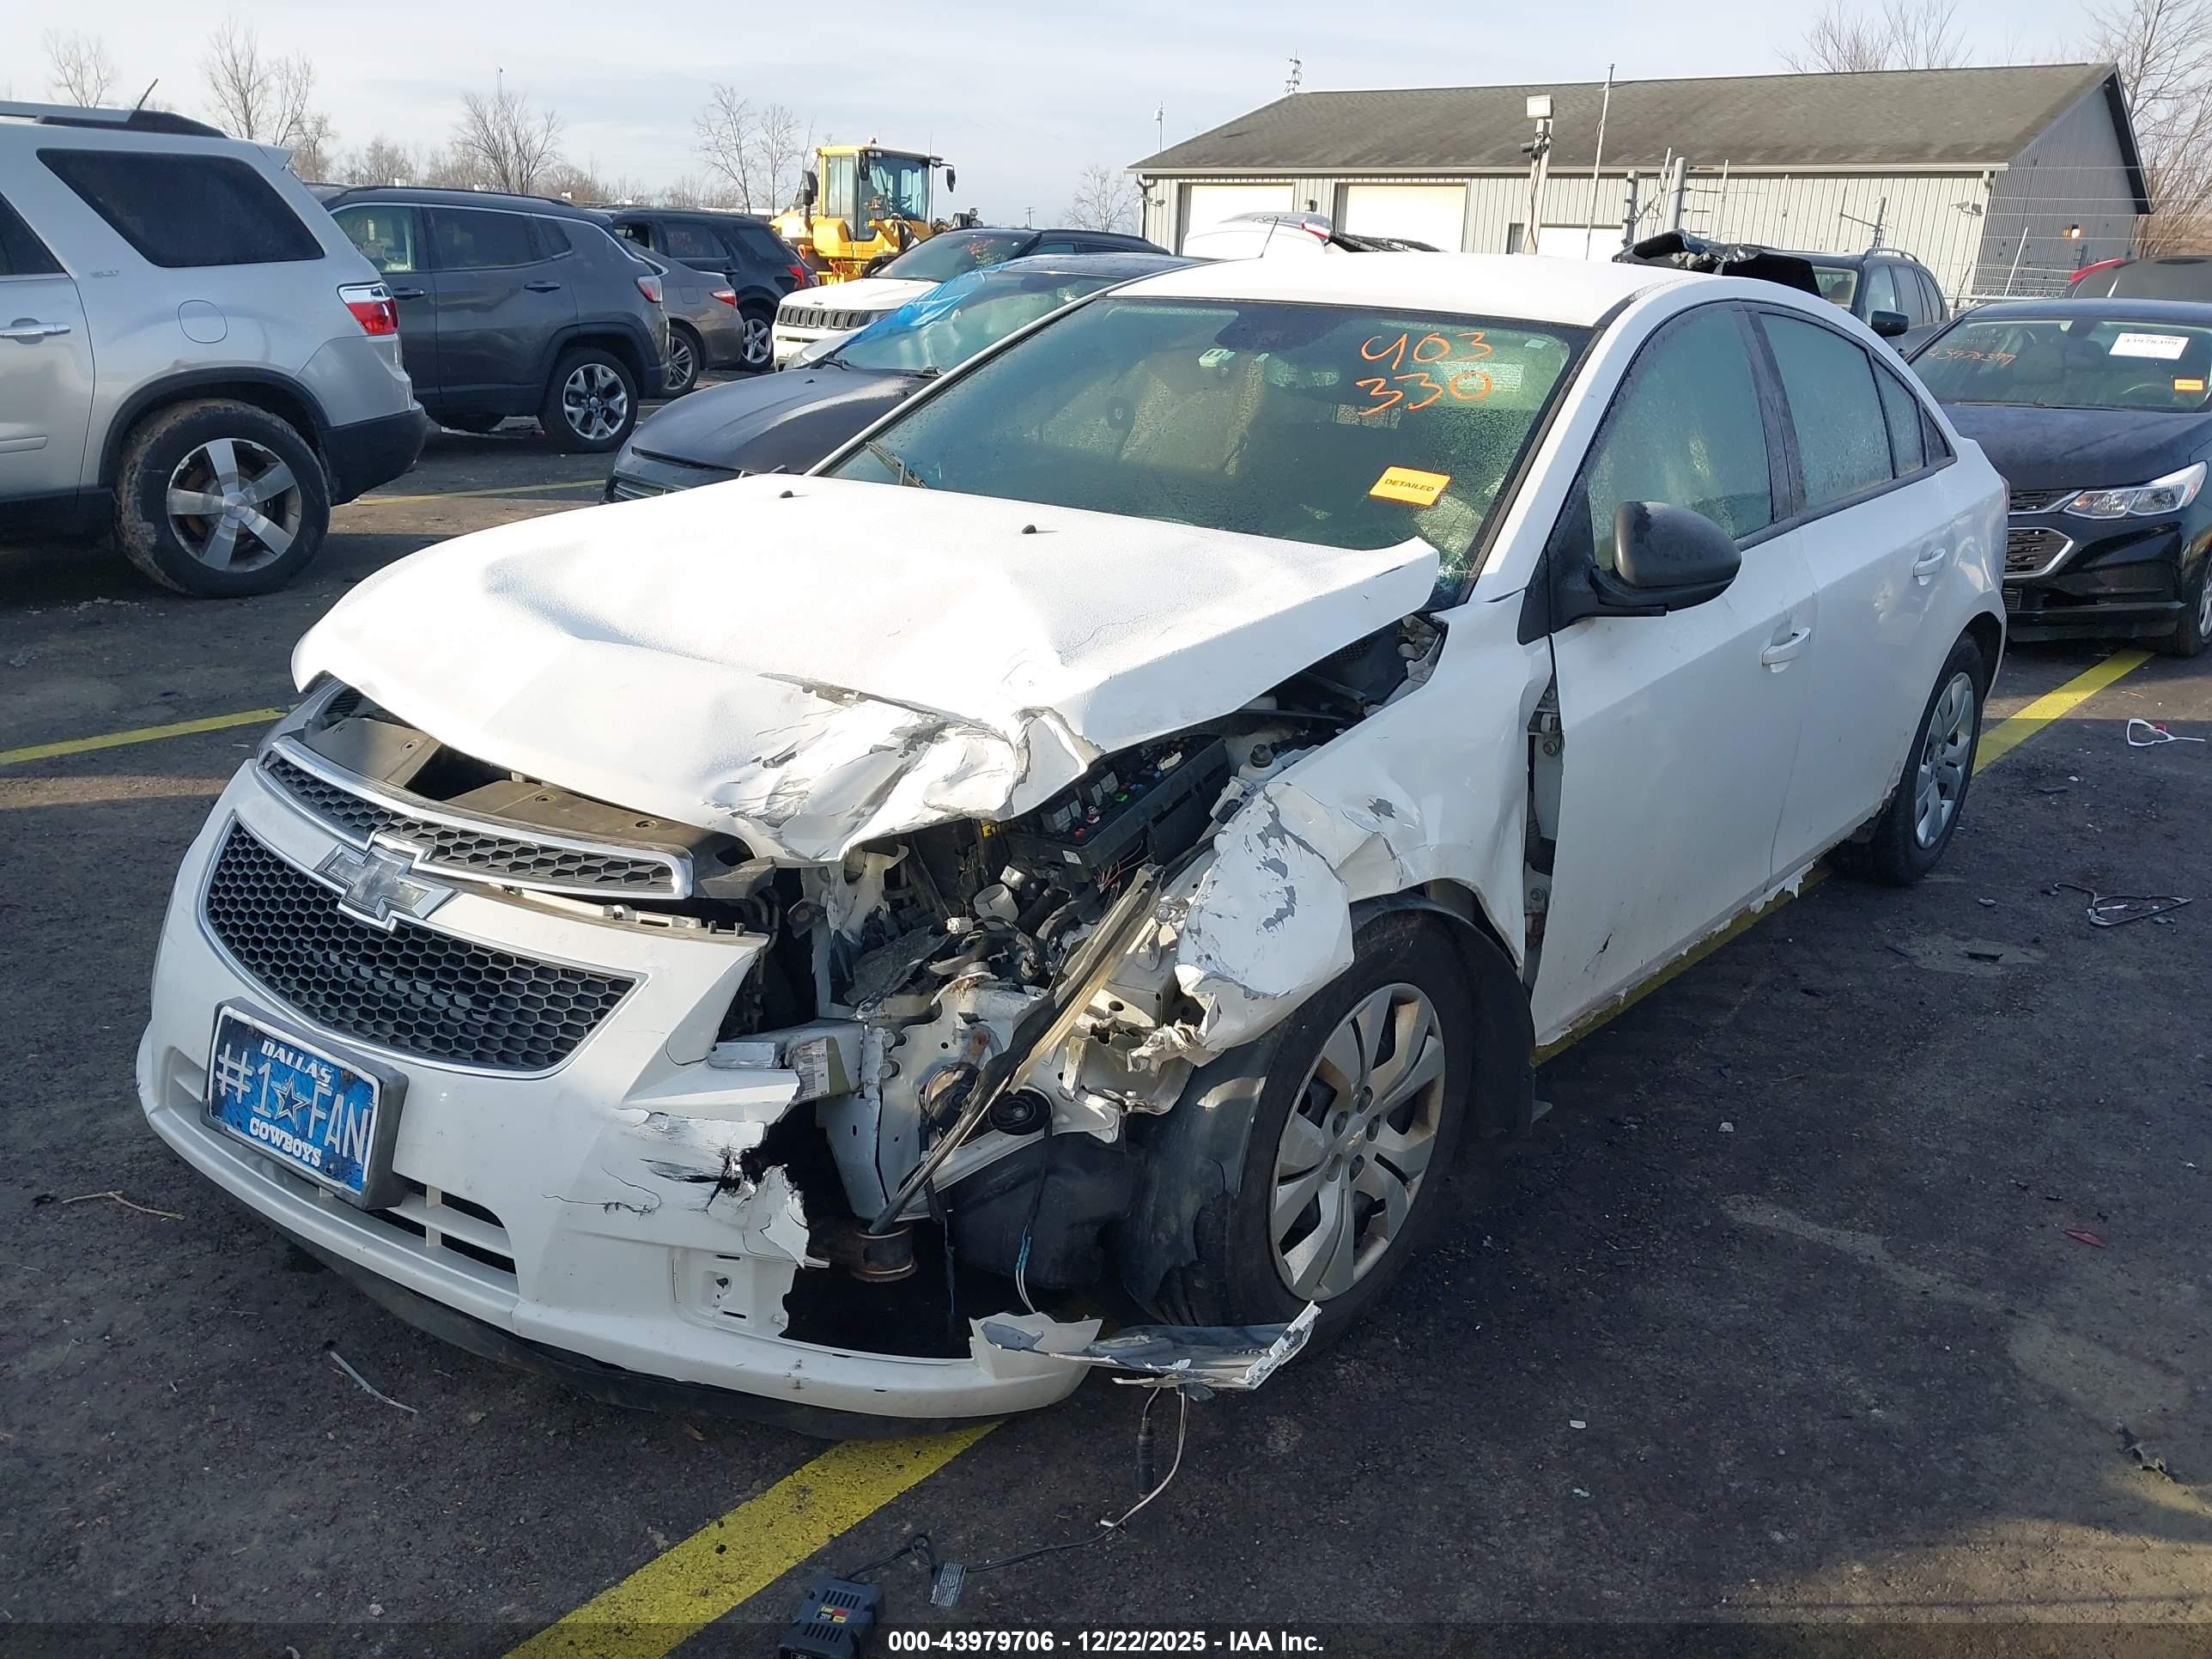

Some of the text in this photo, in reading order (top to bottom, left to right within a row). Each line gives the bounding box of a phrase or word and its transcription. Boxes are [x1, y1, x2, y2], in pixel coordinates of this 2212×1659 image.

[1356, 371, 1493, 416] 330
[1384, 478, 1435, 493] DETAILED
[260, 1039, 333, 1086] DALLAS
[216, 1042, 368, 1165] #1 FAN
[249, 1116, 322, 1168] COWBOYS
